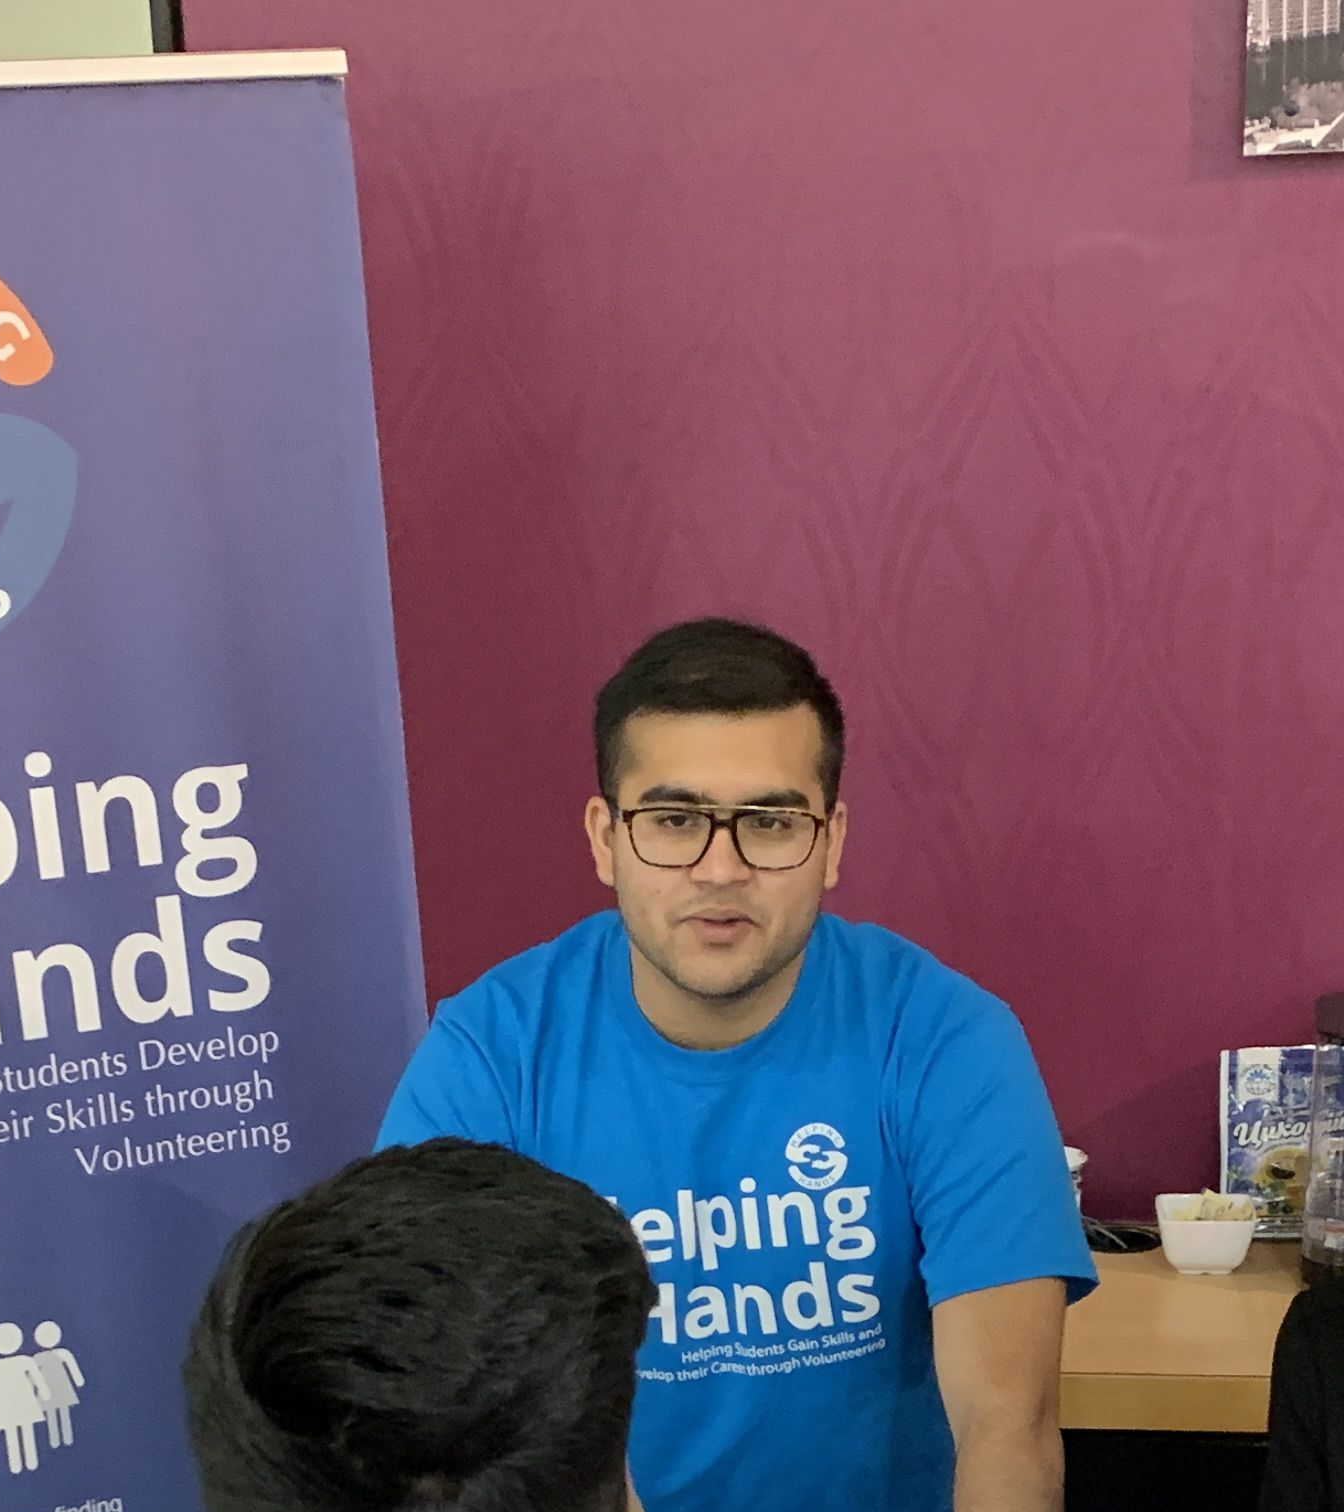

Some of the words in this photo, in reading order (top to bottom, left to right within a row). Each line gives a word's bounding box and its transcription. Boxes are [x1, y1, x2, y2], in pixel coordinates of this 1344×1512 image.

[139, 1027, 279, 1069] Develop
[45, 1092, 135, 1135] Skills
[144, 1070, 274, 1119] through
[74, 1119, 291, 1175] Volunteering
[606, 1177, 877, 1270] elping
[677, 1367, 709, 1382] their
[746, 1357, 801, 1377] through
[802, 1338, 886, 1367] Volunteering
[681, 1344, 733, 1364] Helping
[787, 1338, 819, 1352] Gain
[821, 1331, 855, 1348] Skills
[858, 1322, 883, 1341] and
